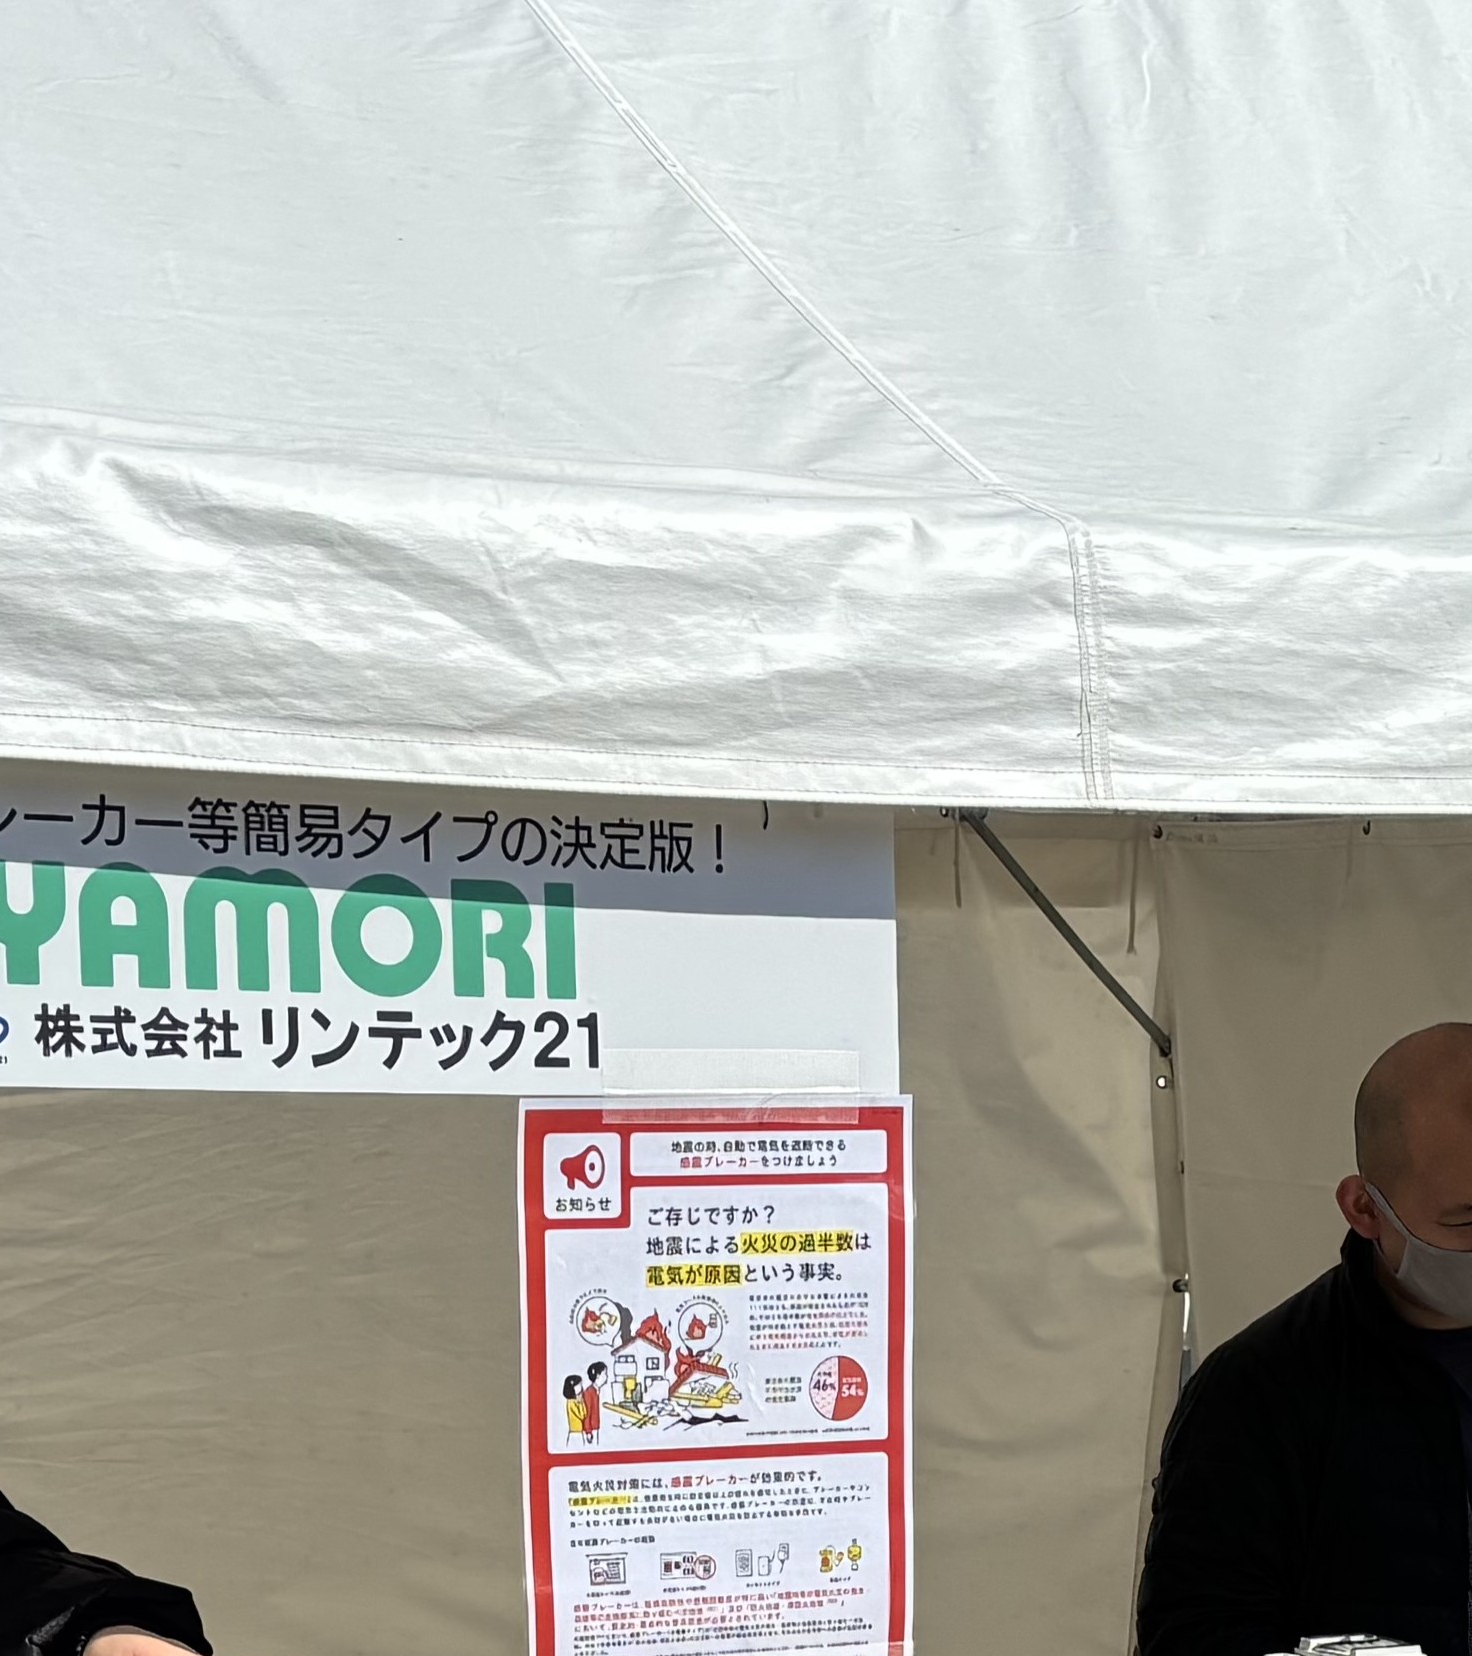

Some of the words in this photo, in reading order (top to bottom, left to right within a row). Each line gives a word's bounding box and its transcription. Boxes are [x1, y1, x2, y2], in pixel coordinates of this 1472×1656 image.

[34, 1002, 243, 1062] 株式会社
[262, 1006, 602, 1071] リンテック21
[555, 1196, 613, 1213] お知らせ
[646, 1205, 776, 1227] ご存じですか？
[645, 1232, 872, 1256] 地震による火災の過半数は
[645, 1262, 844, 1287] 電気が原因という事実。
